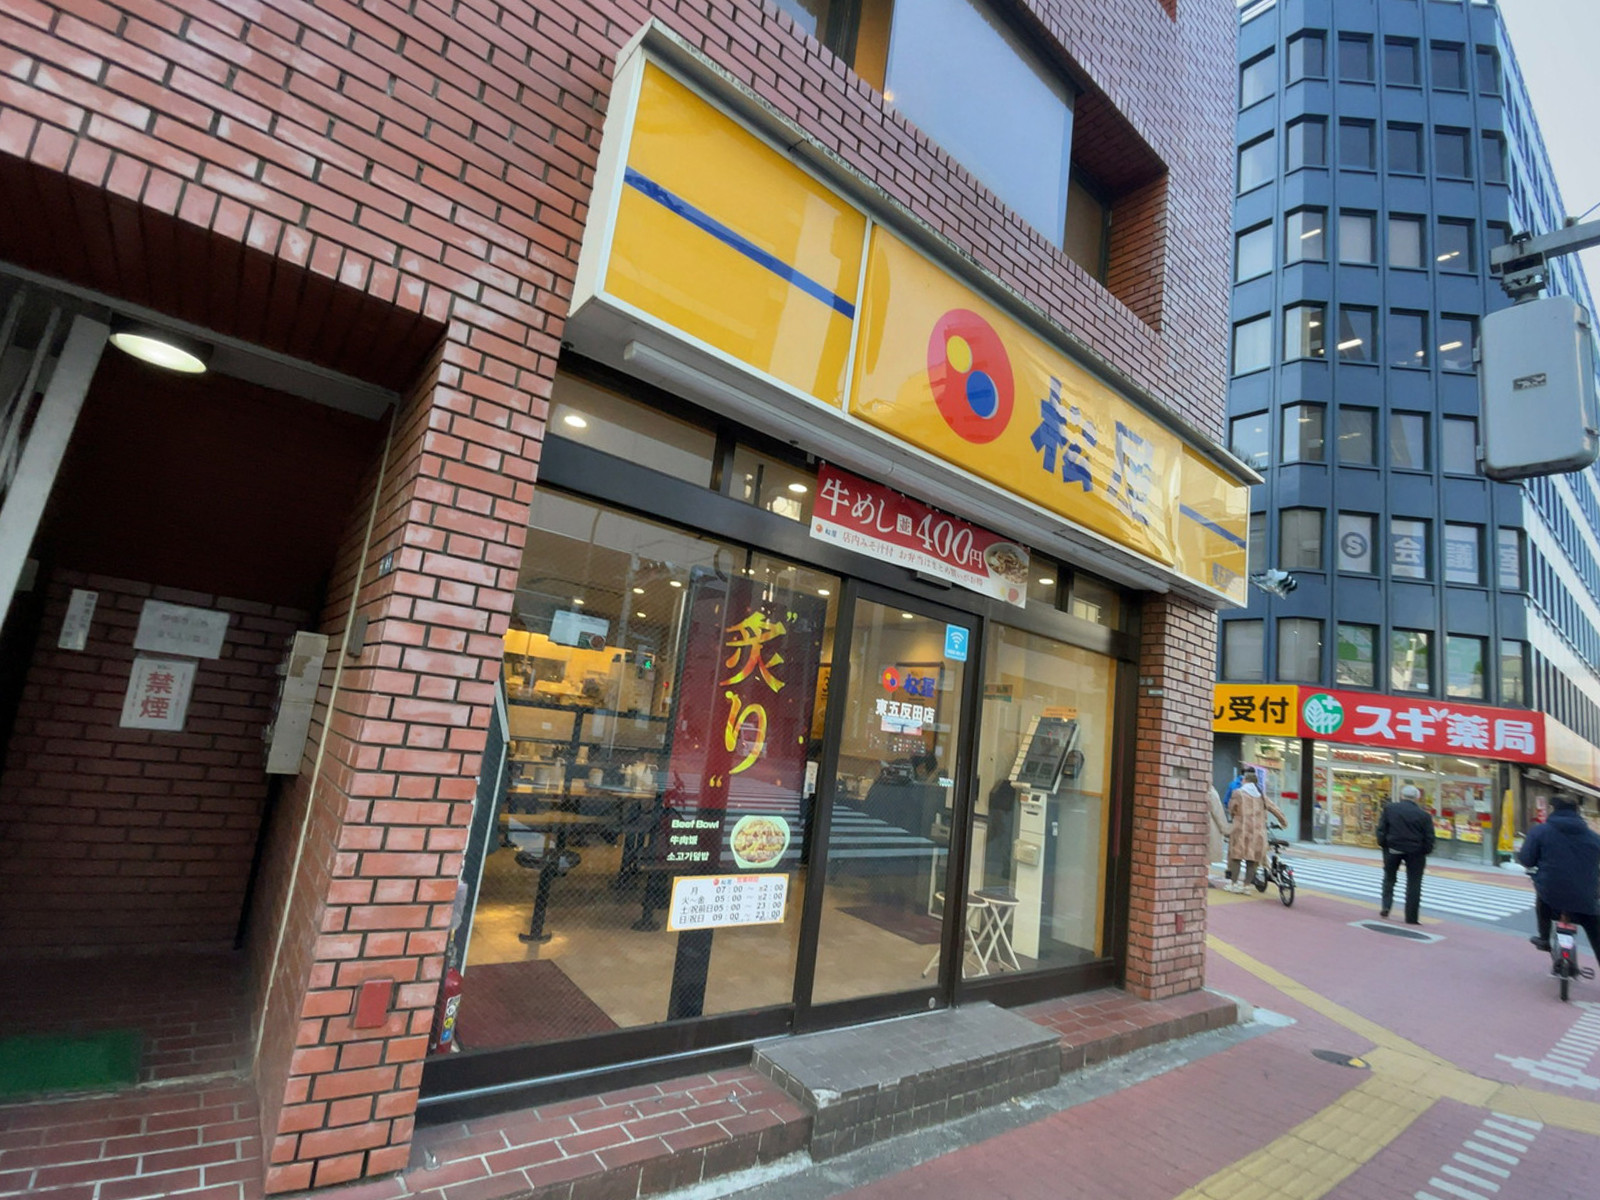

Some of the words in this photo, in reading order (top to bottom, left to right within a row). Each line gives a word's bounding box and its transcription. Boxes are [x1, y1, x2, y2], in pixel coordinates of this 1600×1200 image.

[1030, 376, 1156, 527] 松屋
[820, 478, 894, 533] 牛めし
[916, 514, 983, 569] 400円
[139, 671, 175, 720] 禁煙
[903, 673, 936, 698] 松屋
[875, 698, 936, 724] 東五反田店
[1354, 705, 1536, 756] スギ薬局
[672, 819, 695, 828] Beef
[696, 819, 719, 828] Bowl
